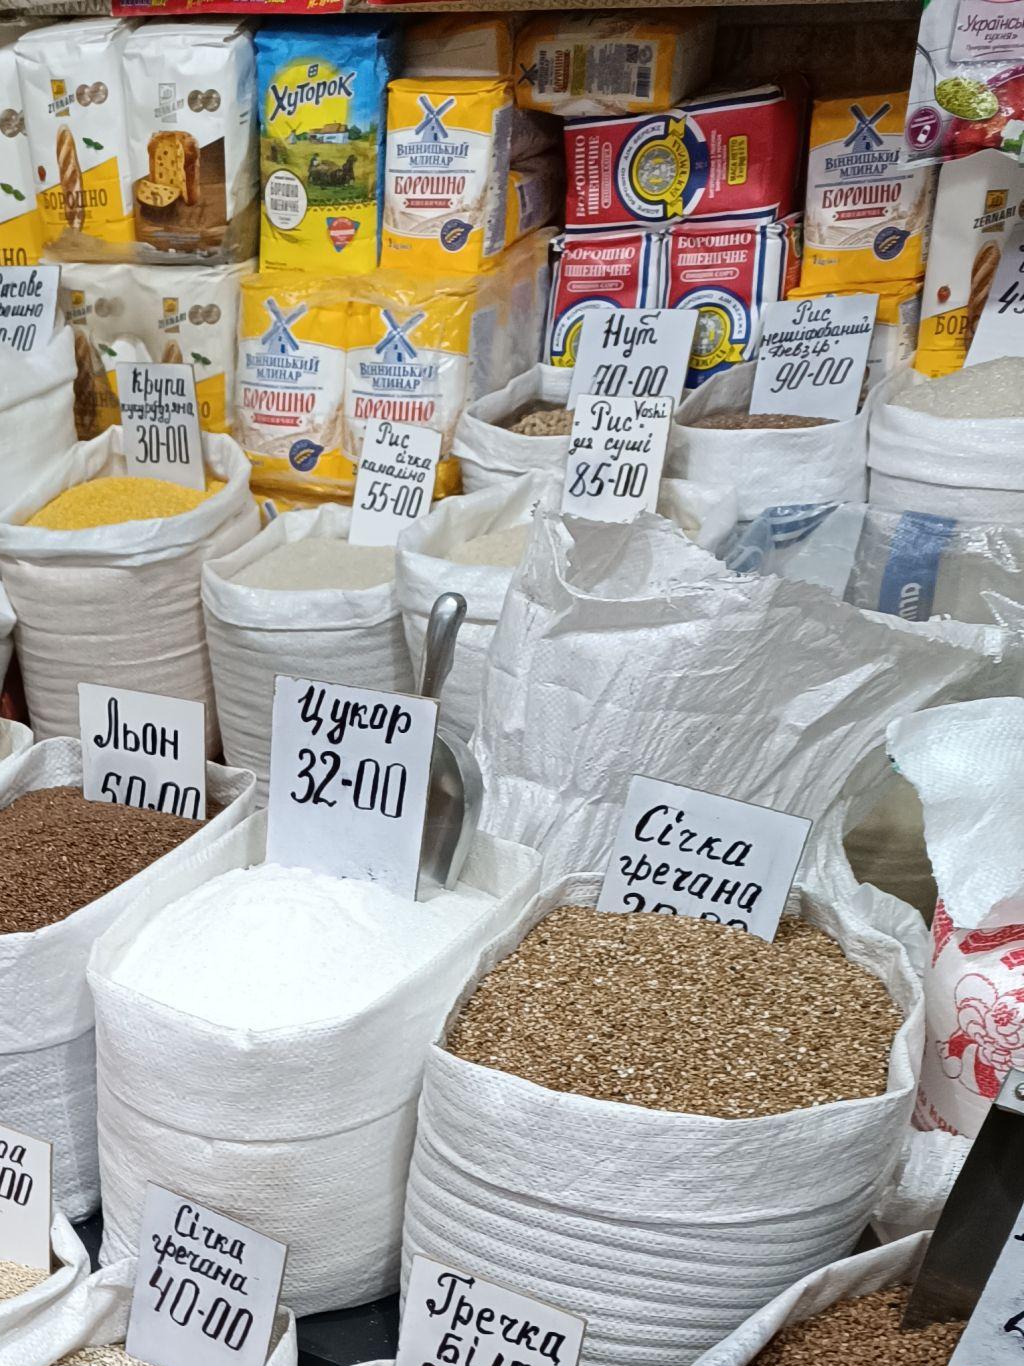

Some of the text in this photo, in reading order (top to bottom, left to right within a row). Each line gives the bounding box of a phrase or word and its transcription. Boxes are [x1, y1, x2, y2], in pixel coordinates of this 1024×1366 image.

[397, 142, 469, 157] ВІННИЦЬКИЙ
[409, 156, 453, 167] МЛИНАР
[394, 176, 466, 195] БОРОШНО
[840, 164, 887, 179] МЛИНАР
[43, 188, 108, 210] БОРОШНО
[822, 183, 902, 209] БОРОШНО
[974, 206, 1017, 228] ZERNARI
[678, 233, 752, 249] БОРОШНО
[677, 250, 748, 265] ПШЕНИЧНЕ
[792, 300, 831, 325] Рис
[602, 311, 662, 357] Нут
[246, 353, 320, 374] ВІННИЦЬКИЙ
[256, 366, 302, 382] МЛИНАР
[770, 357, 854, 393] 90-00
[132, 368, 186, 406] Крупа
[372, 375, 421, 391] МЛИНАР
[592, 364, 668, 398] 70-00
[243, 387, 316, 413] БОРОШНО
[354, 396, 436, 421] БОРОШНО
[590, 400, 632, 432] Рис
[136, 424, 190, 464] 30-00
[376, 422, 410, 449] Рис
[604, 433, 653, 461] суші
[569, 462, 648, 497] 85-00
[361, 481, 424, 518] 55-00
[93, 696, 179, 760] Льон
[297, 685, 412, 745] Цукор
[290, 748, 407, 819] 32-00
[634, 804, 754, 868] Січка
[619, 853, 763, 914] гречана
[174, 1205, 246, 1265] Січка
[152, 1234, 249, 1296] гречана
[149, 1266, 254, 1351] 40-00
[426, 1272, 566, 1366] Гречка
